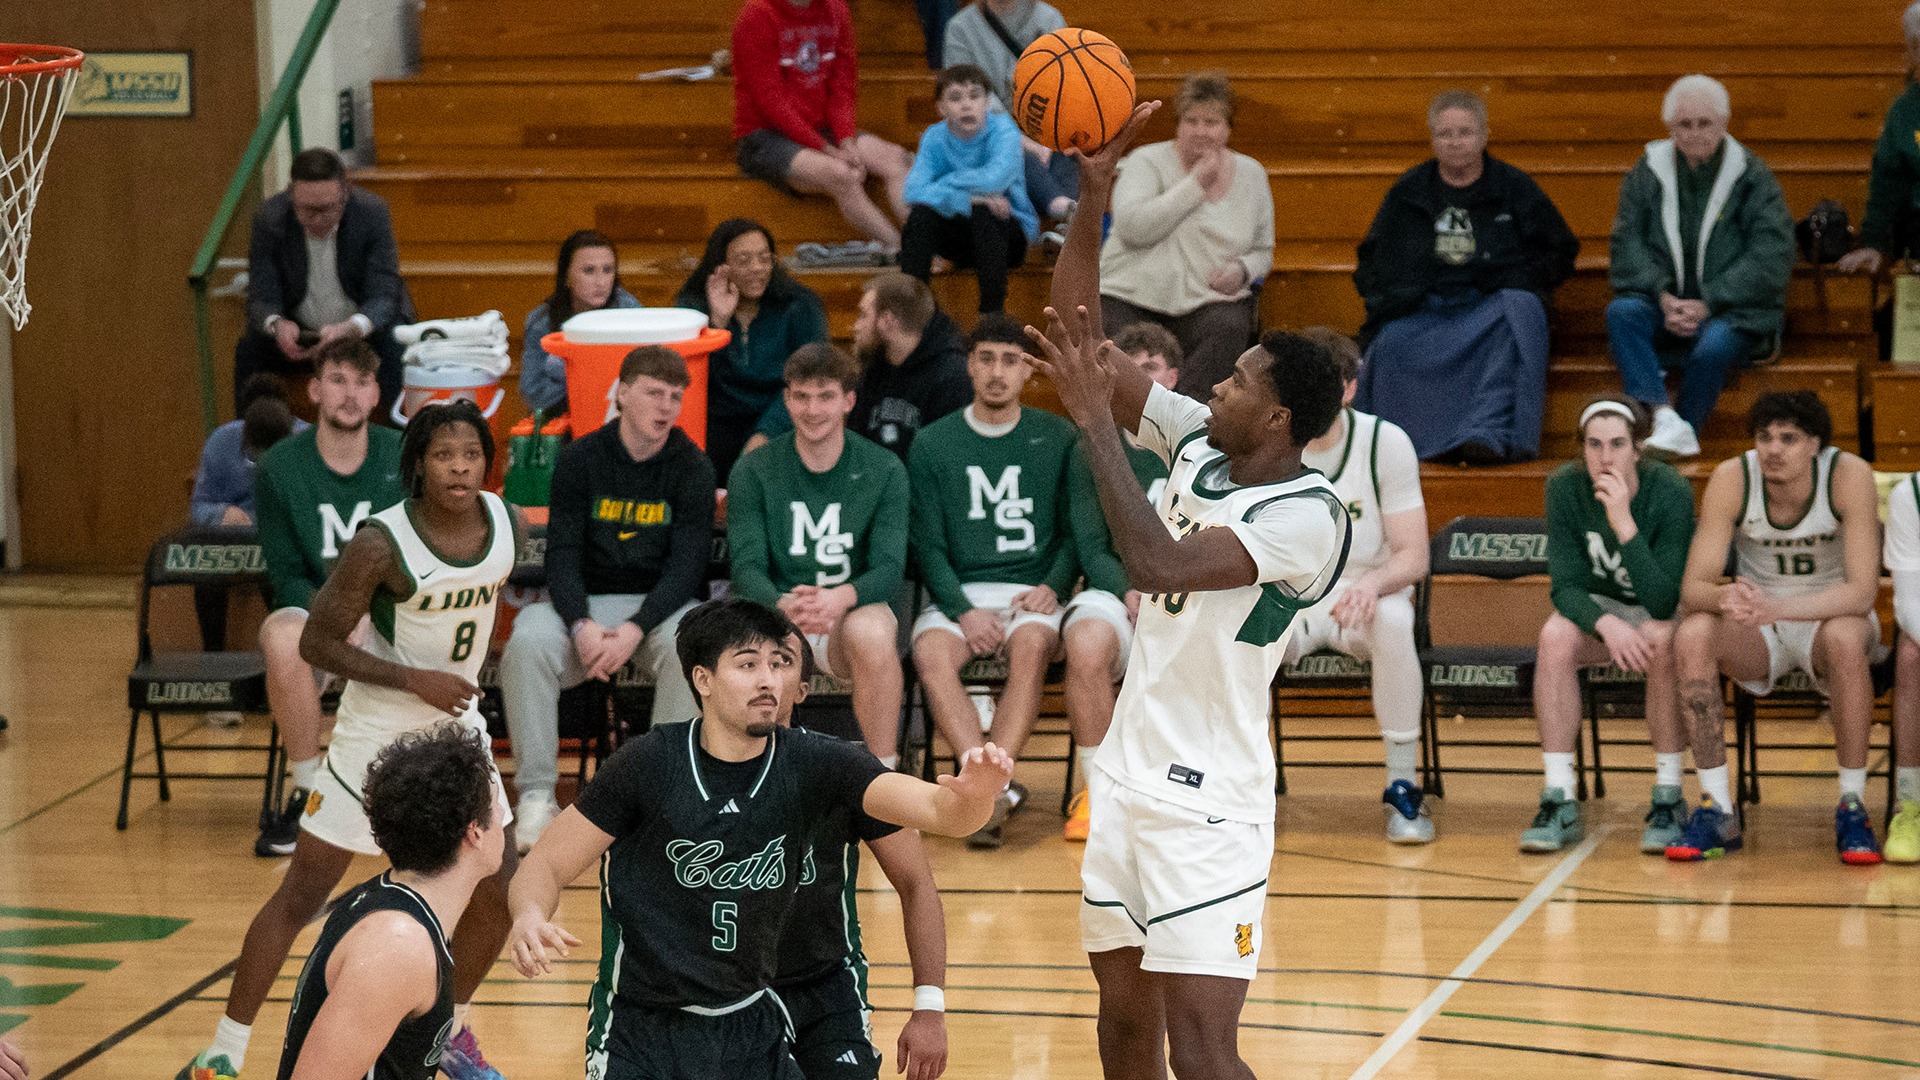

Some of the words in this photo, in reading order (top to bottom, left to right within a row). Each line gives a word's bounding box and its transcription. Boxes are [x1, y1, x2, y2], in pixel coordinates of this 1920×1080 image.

[1774, 553, 1816, 575] 16
[417, 582, 508, 611] LION
[450, 619, 477, 662] 8
[1430, 665, 1517, 687] LIONS
[147, 682, 234, 703] LIONS
[1189, 774, 1200, 784] XL
[666, 834, 787, 890] Cats
[712, 901, 738, 952] 5
